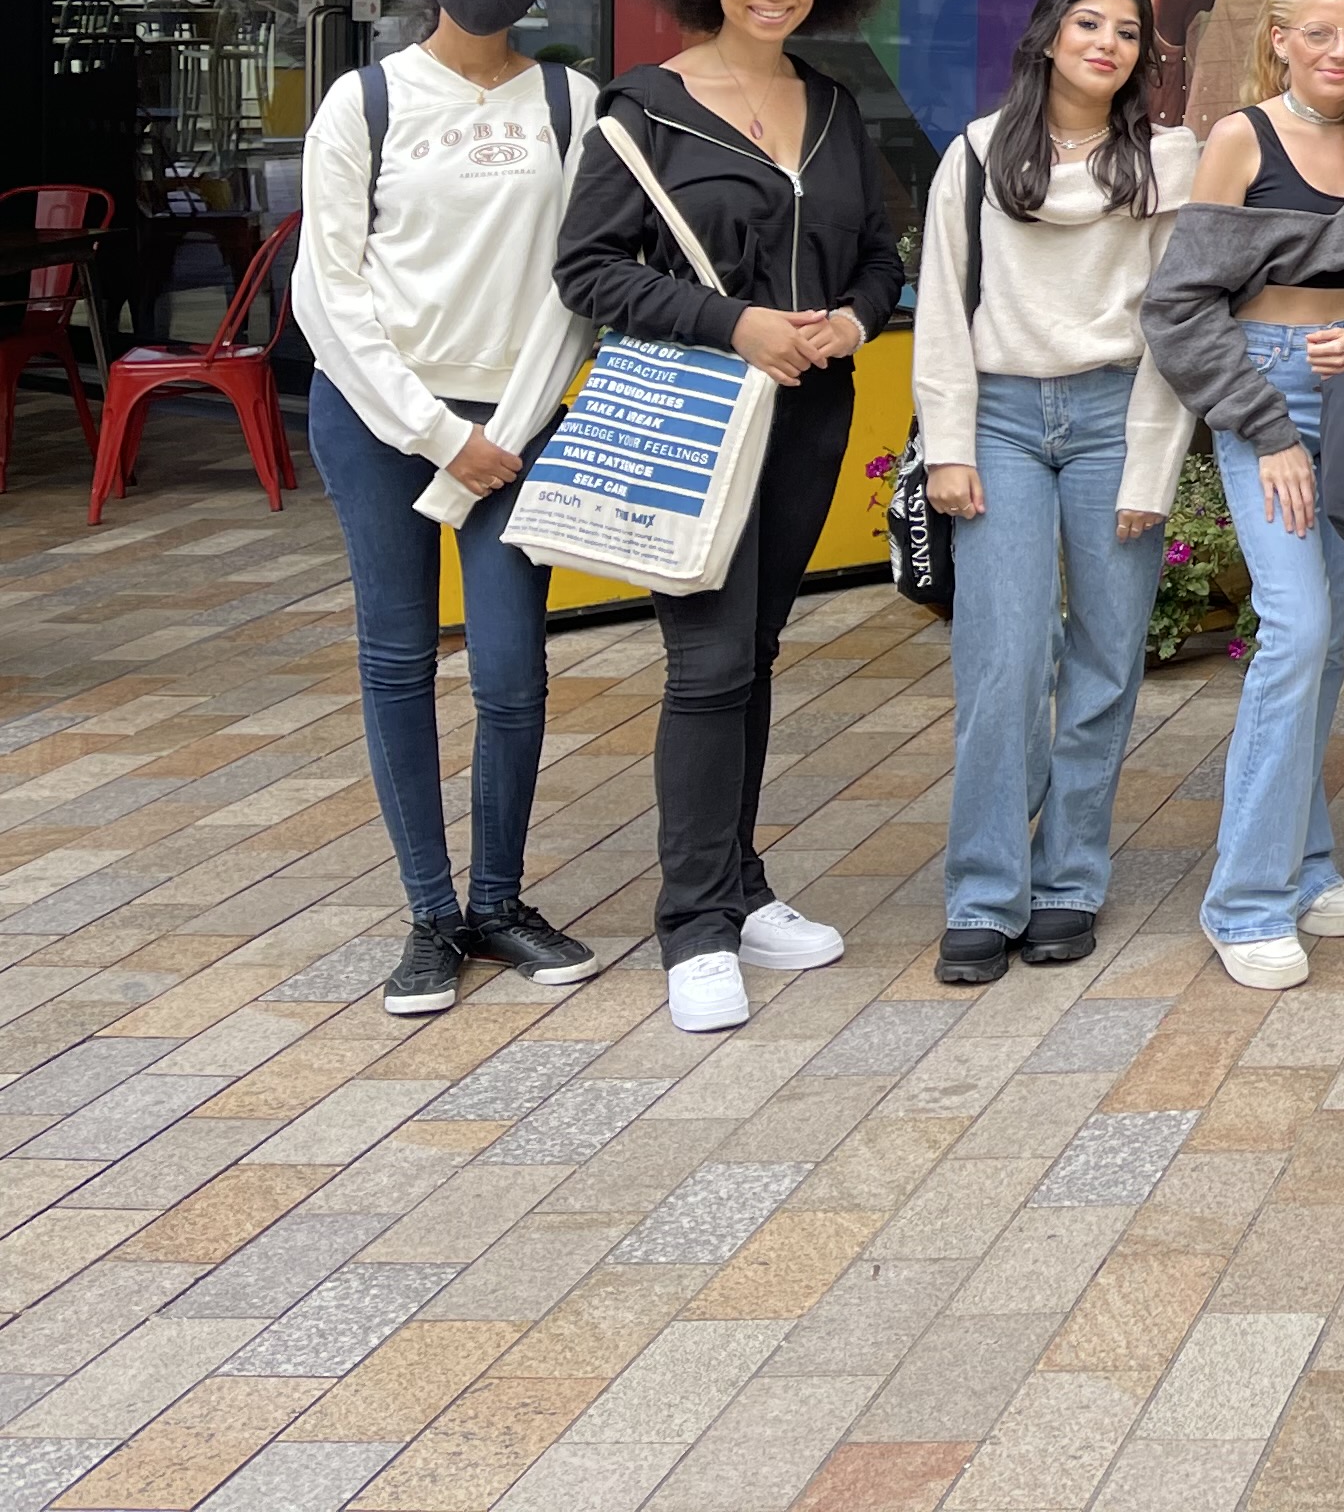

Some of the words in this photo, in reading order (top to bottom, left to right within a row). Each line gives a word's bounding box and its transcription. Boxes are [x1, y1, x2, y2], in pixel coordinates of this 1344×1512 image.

[411, 122, 551, 160] COBRA
[606, 356, 634, 372] KEEP
[633, 366, 677, 383] ACTIVE
[607, 380, 685, 409] BOUNDARIES
[585, 400, 613, 416] TAKE
[615, 409, 623, 419] A
[563, 445, 596, 462] HAVE
[643, 440, 710, 465] FEELINGS
[572, 472, 604, 488] SELF
[538, 490, 581, 509] schuh
[631, 512, 657, 529] MIX
